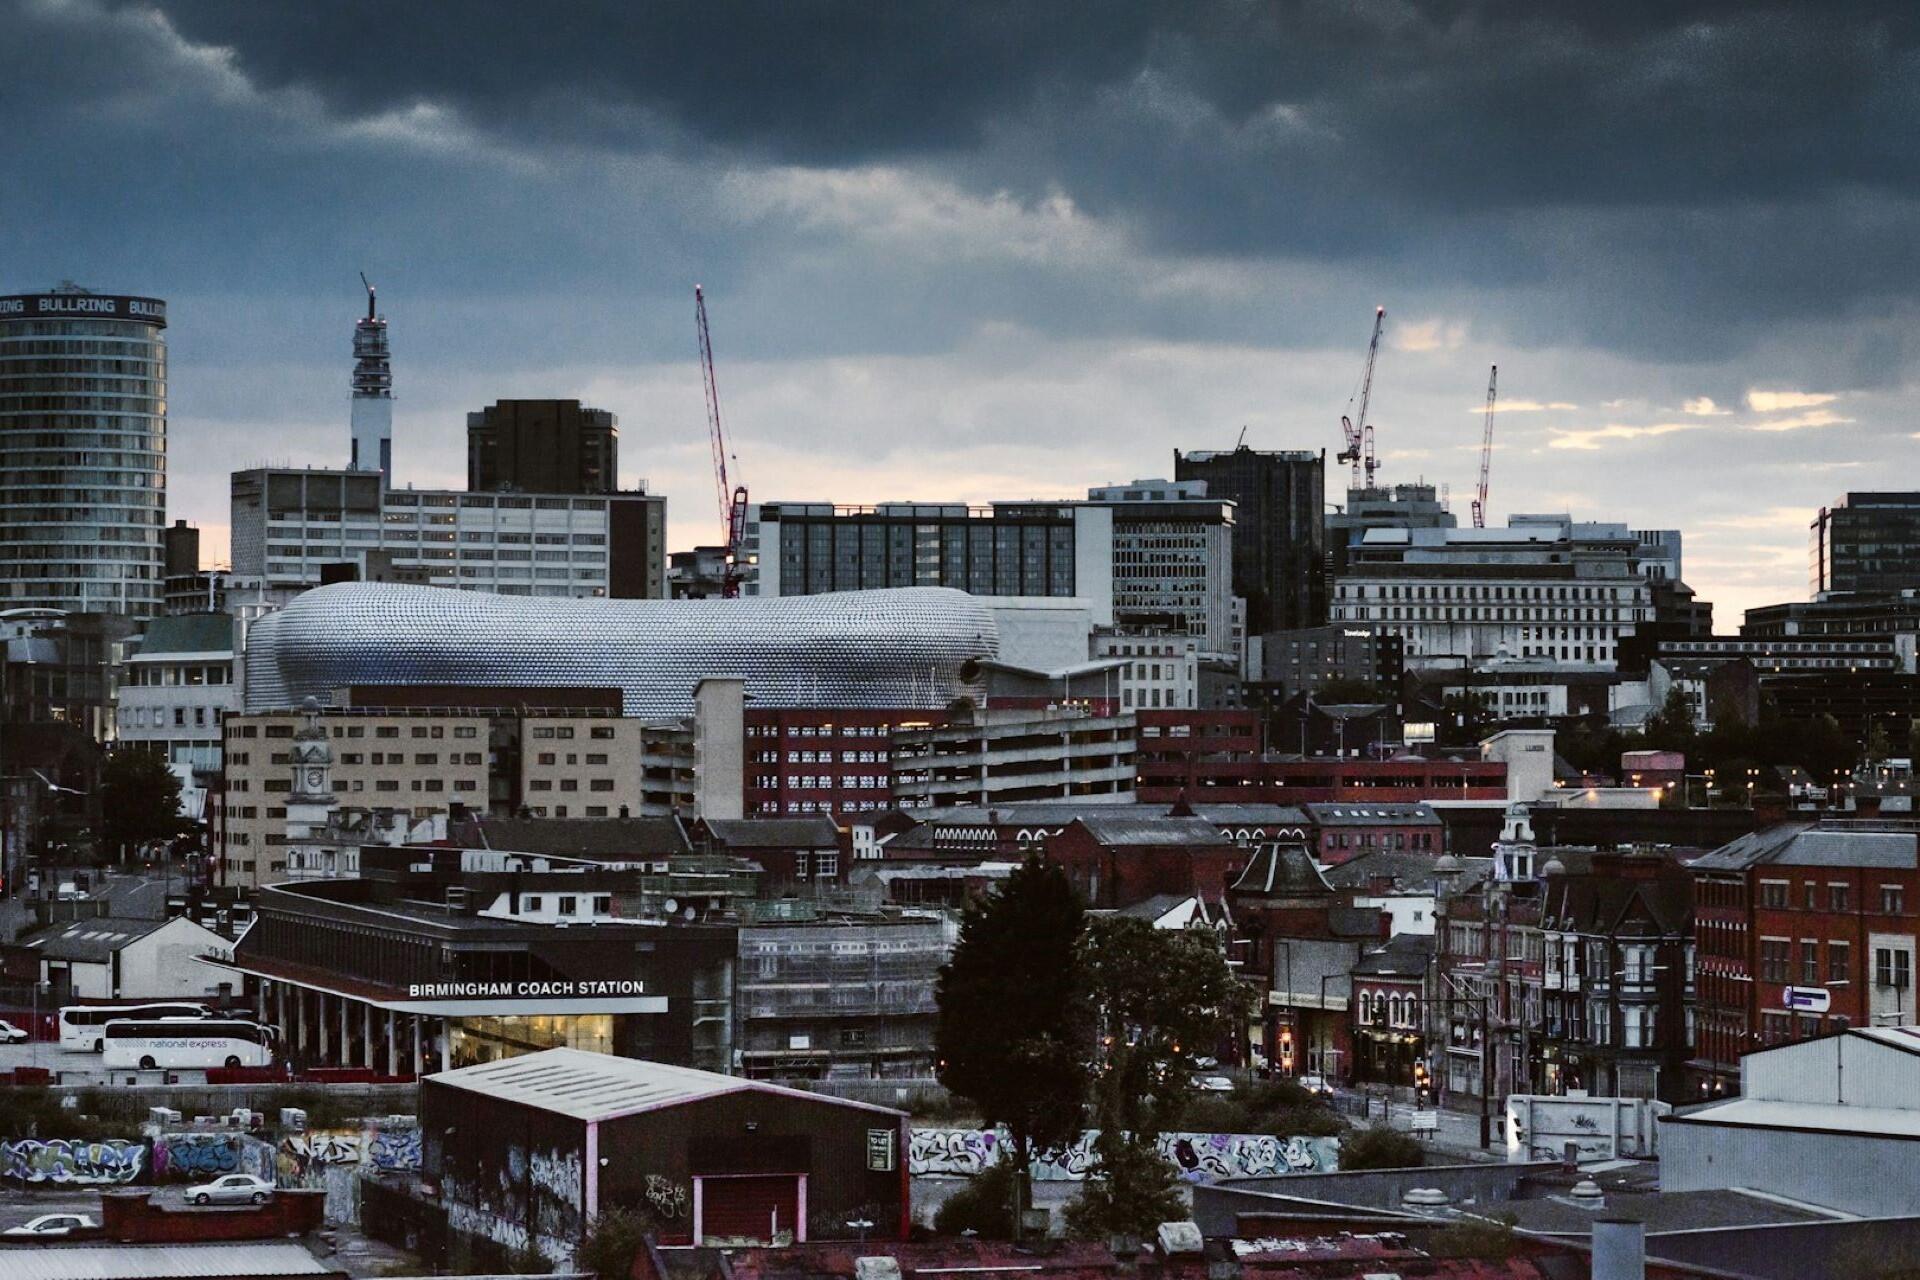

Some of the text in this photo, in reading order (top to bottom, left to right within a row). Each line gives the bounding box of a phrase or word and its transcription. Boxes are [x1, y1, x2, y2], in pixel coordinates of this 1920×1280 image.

[0, 300, 24, 313] ING
[38, 298, 115, 313] BULLRING
[409, 980, 644, 997] BIRMINGHAM COACH STATION
[149, 1039, 228, 1050] national express
